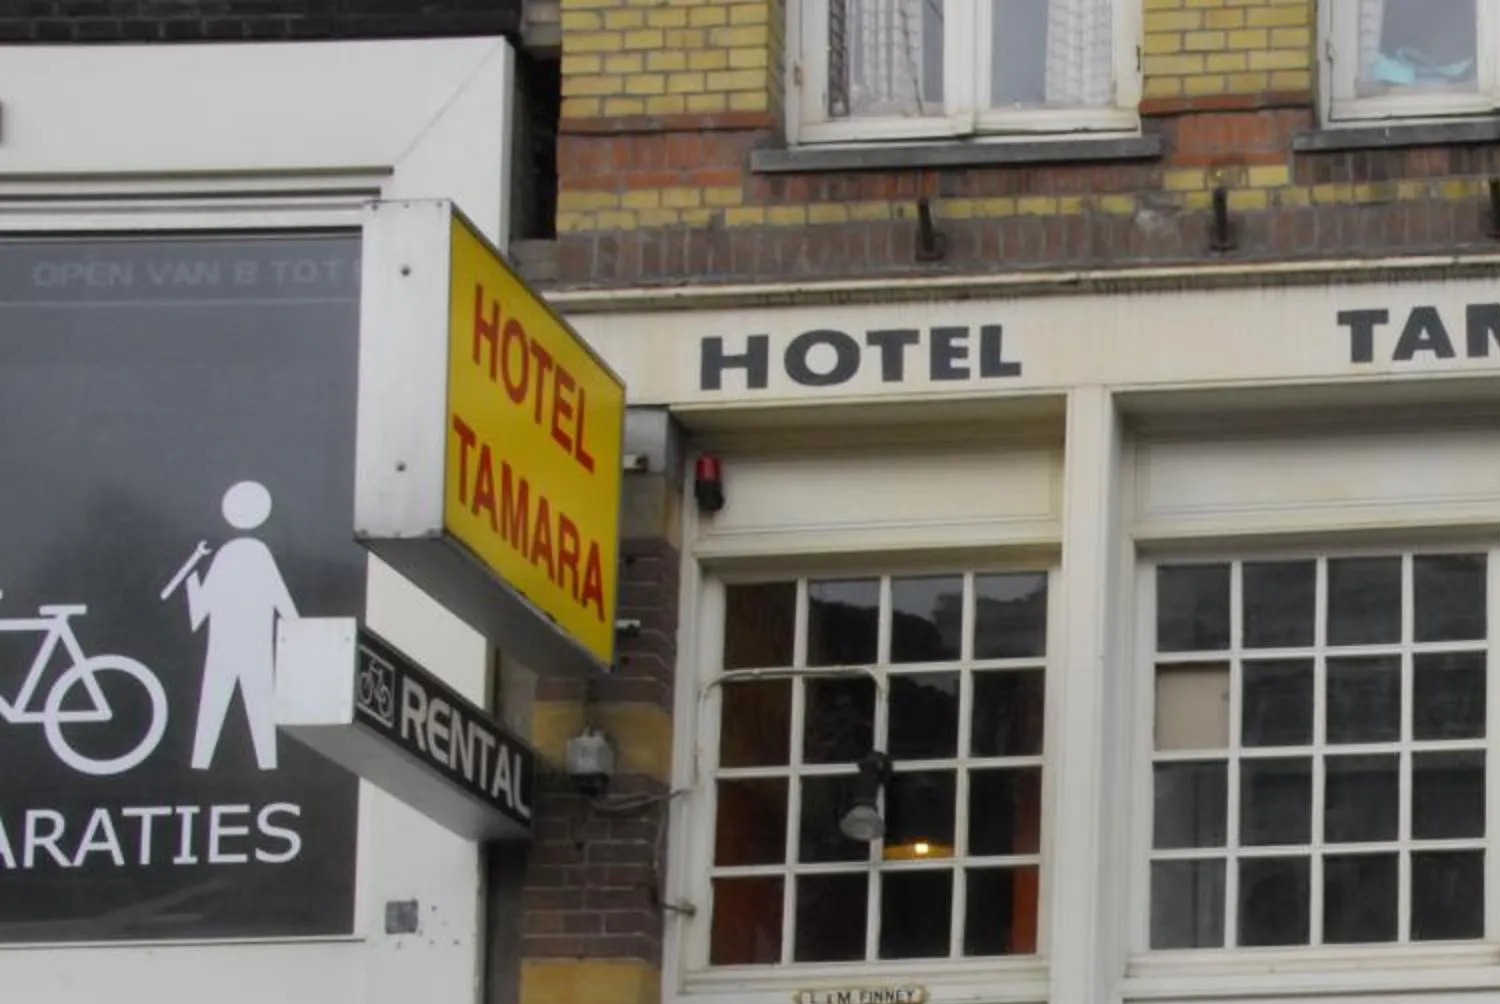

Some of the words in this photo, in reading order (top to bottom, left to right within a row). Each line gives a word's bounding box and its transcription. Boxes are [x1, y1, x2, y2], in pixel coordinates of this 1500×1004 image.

[31, 261, 136, 288] OPEN
[145, 260, 221, 287] VAN
[270, 258, 344, 287] TOT
[472, 282, 595, 474] HOTEL
[699, 323, 1023, 391] HOTEL
[452, 416, 606, 623] TAMARA
[400, 673, 531, 822] RENTAL
[0, 800, 303, 870] RATIES
